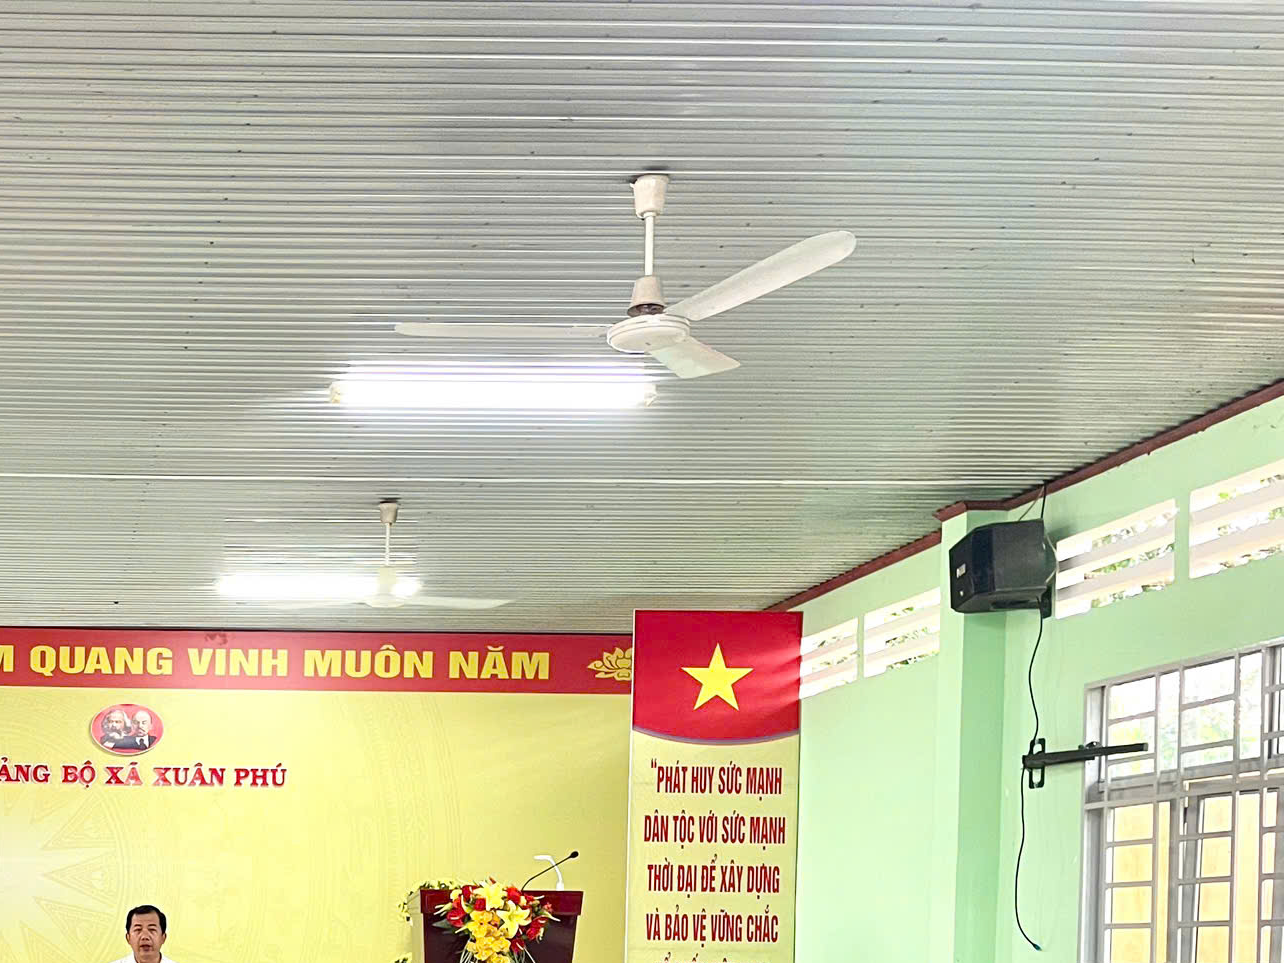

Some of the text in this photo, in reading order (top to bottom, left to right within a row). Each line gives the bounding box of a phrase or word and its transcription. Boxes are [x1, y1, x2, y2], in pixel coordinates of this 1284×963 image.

[29, 645, 173, 677] QUANG
[187, 648, 288, 677] VINH
[303, 644, 434, 679] MUÔN
[449, 645, 550, 680] NĂM
[62, 760, 96, 789] BỘ
[105, 762, 143, 786] XÃ
[152, 762, 226, 787] XUÂN
[233, 763, 287, 787] PHÚ
[691, 766, 715, 794] HUY
[718, 760, 742, 794] SỨC
[746, 767, 783, 801] MẠNH
[643, 809, 786, 850] DÂN TỘC VỚI SỨC MẠNH
[647, 854, 780, 900] THỜI ĐẠI ĐỂ XÂY DỰNG
[646, 904, 779, 948] VÀ BẢO VỆ VỮNG CHẮC
